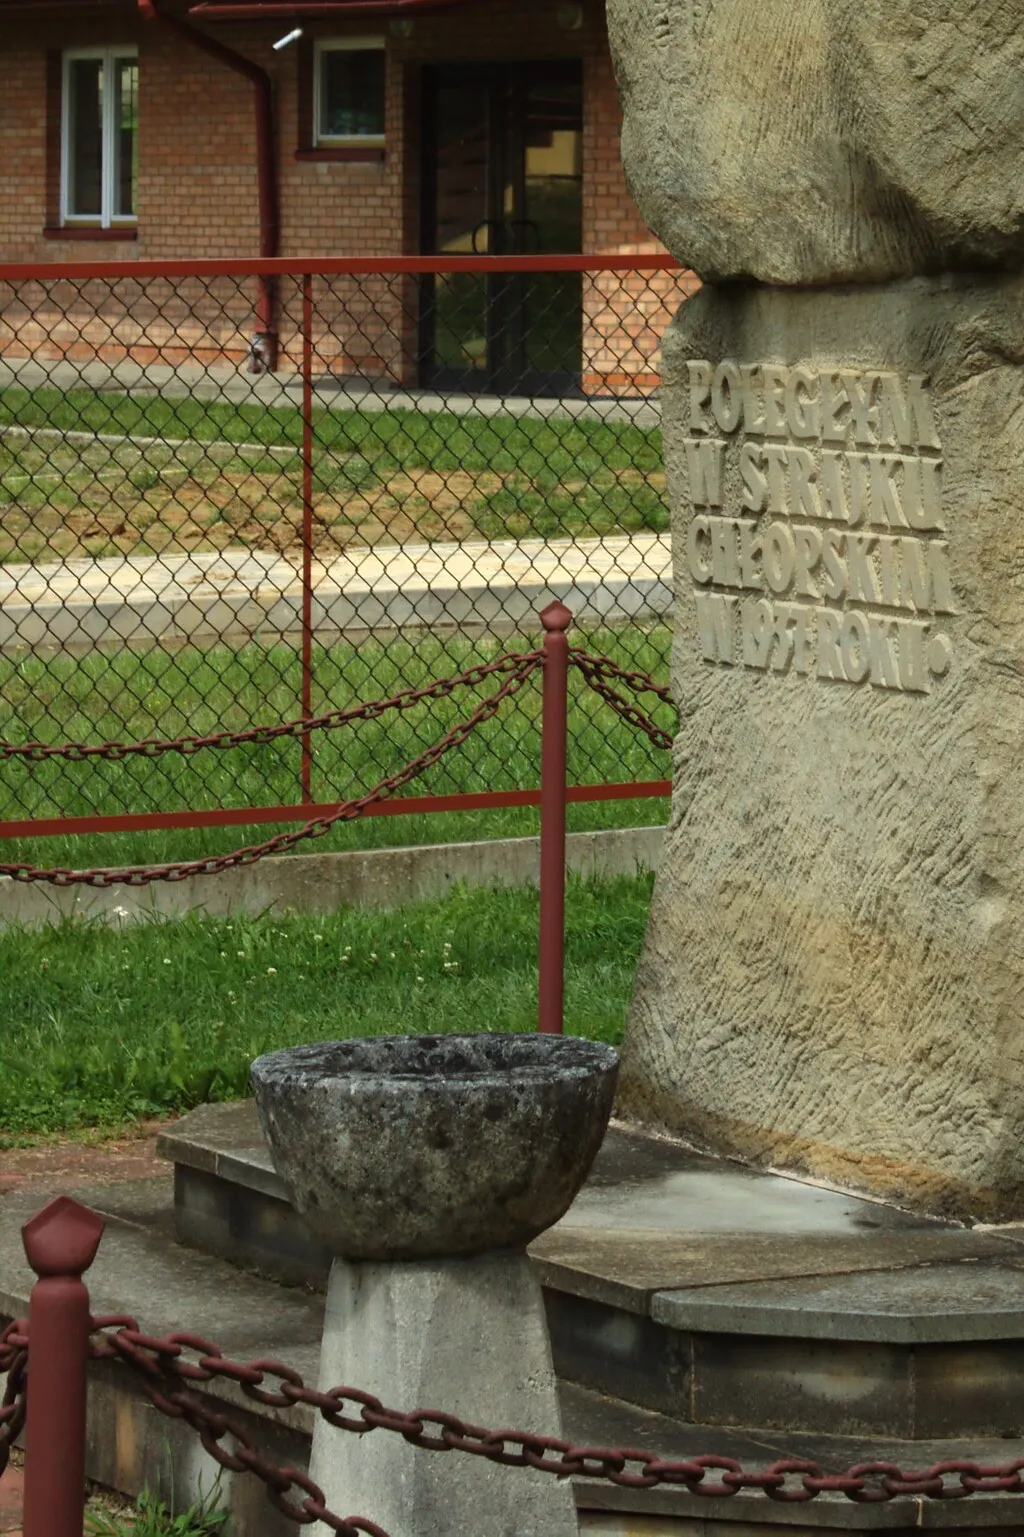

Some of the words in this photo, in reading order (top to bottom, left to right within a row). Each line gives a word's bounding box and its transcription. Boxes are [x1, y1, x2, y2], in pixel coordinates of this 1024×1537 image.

[686, 357, 942, 450] POLEGŁYM
[683, 437, 728, 508] W
[740, 442, 945, 532] STRAJKU
[687, 514, 958, 616] CHŁOPSKIM
[693, 590, 738, 664] W
